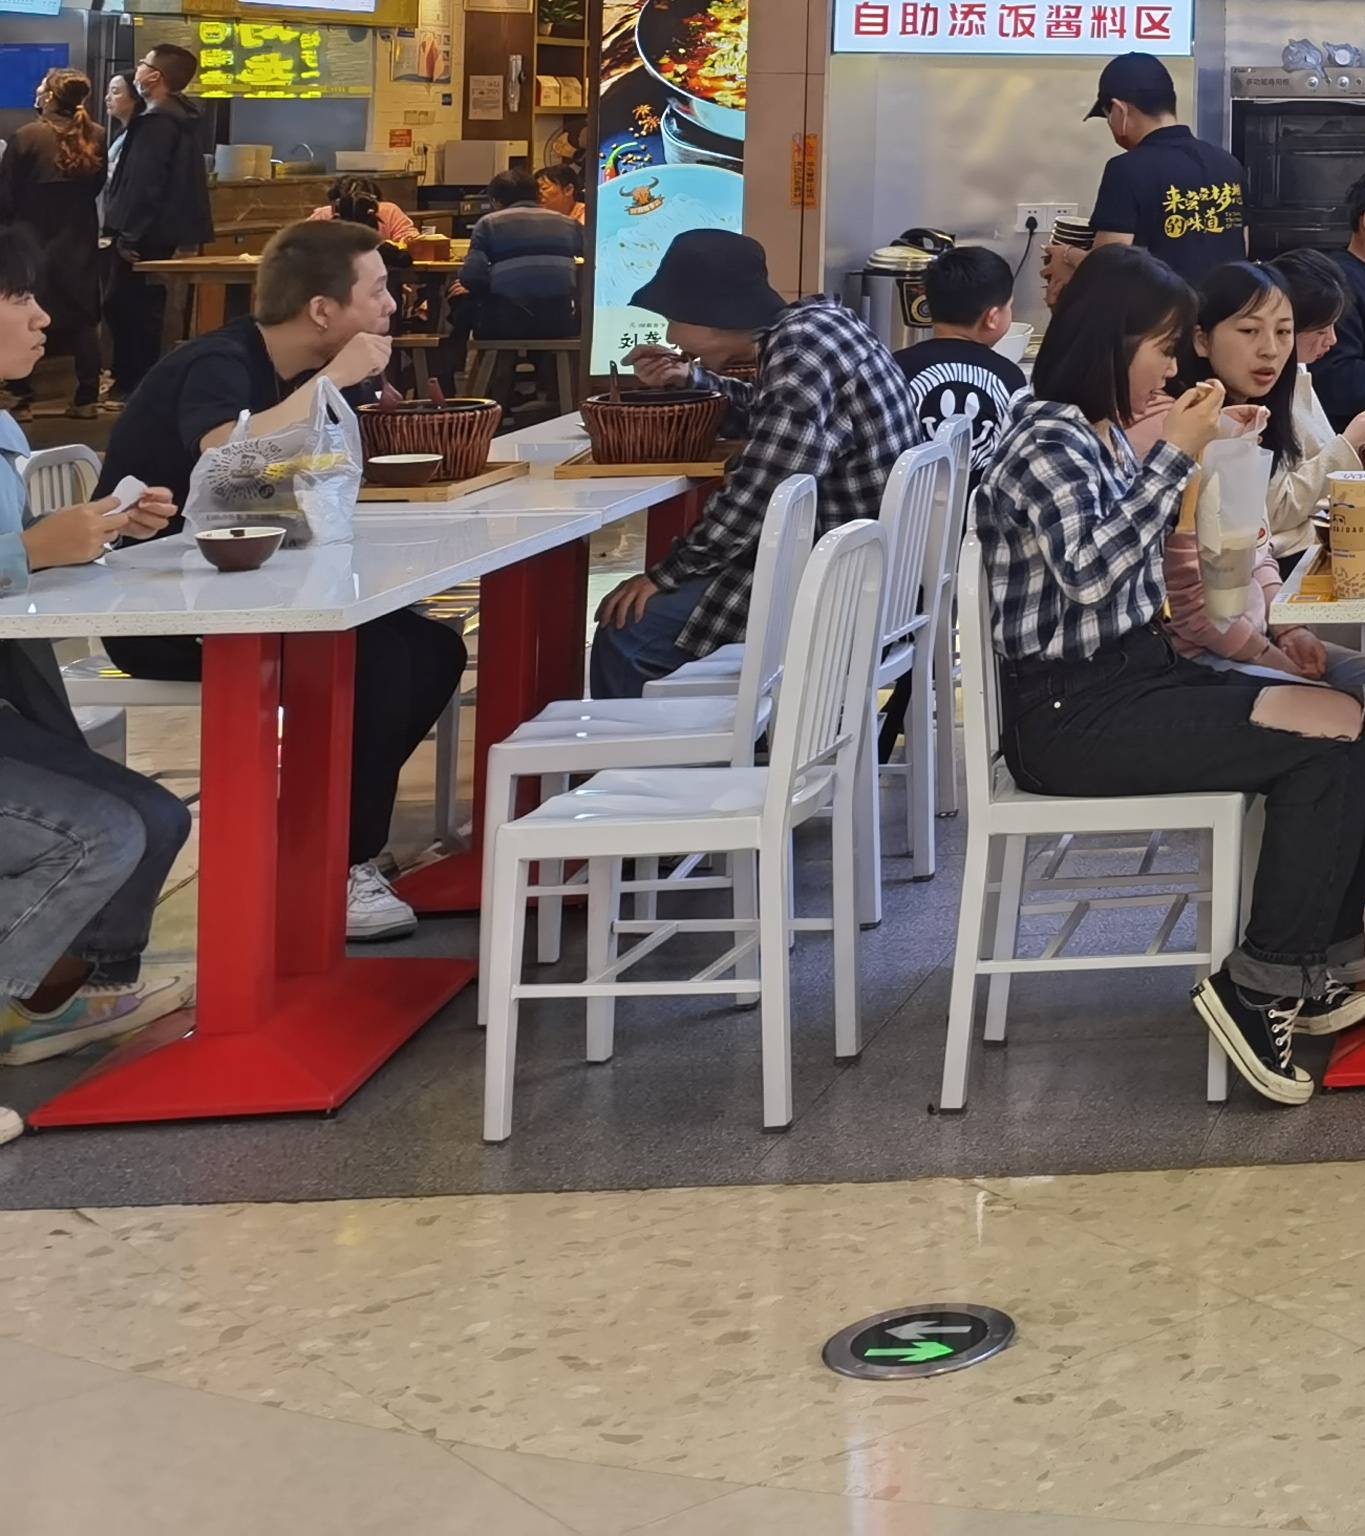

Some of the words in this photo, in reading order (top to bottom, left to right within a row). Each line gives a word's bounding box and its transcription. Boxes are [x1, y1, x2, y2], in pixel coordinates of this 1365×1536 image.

[853, 1, 1173, 40] 自助添饭酱料区
